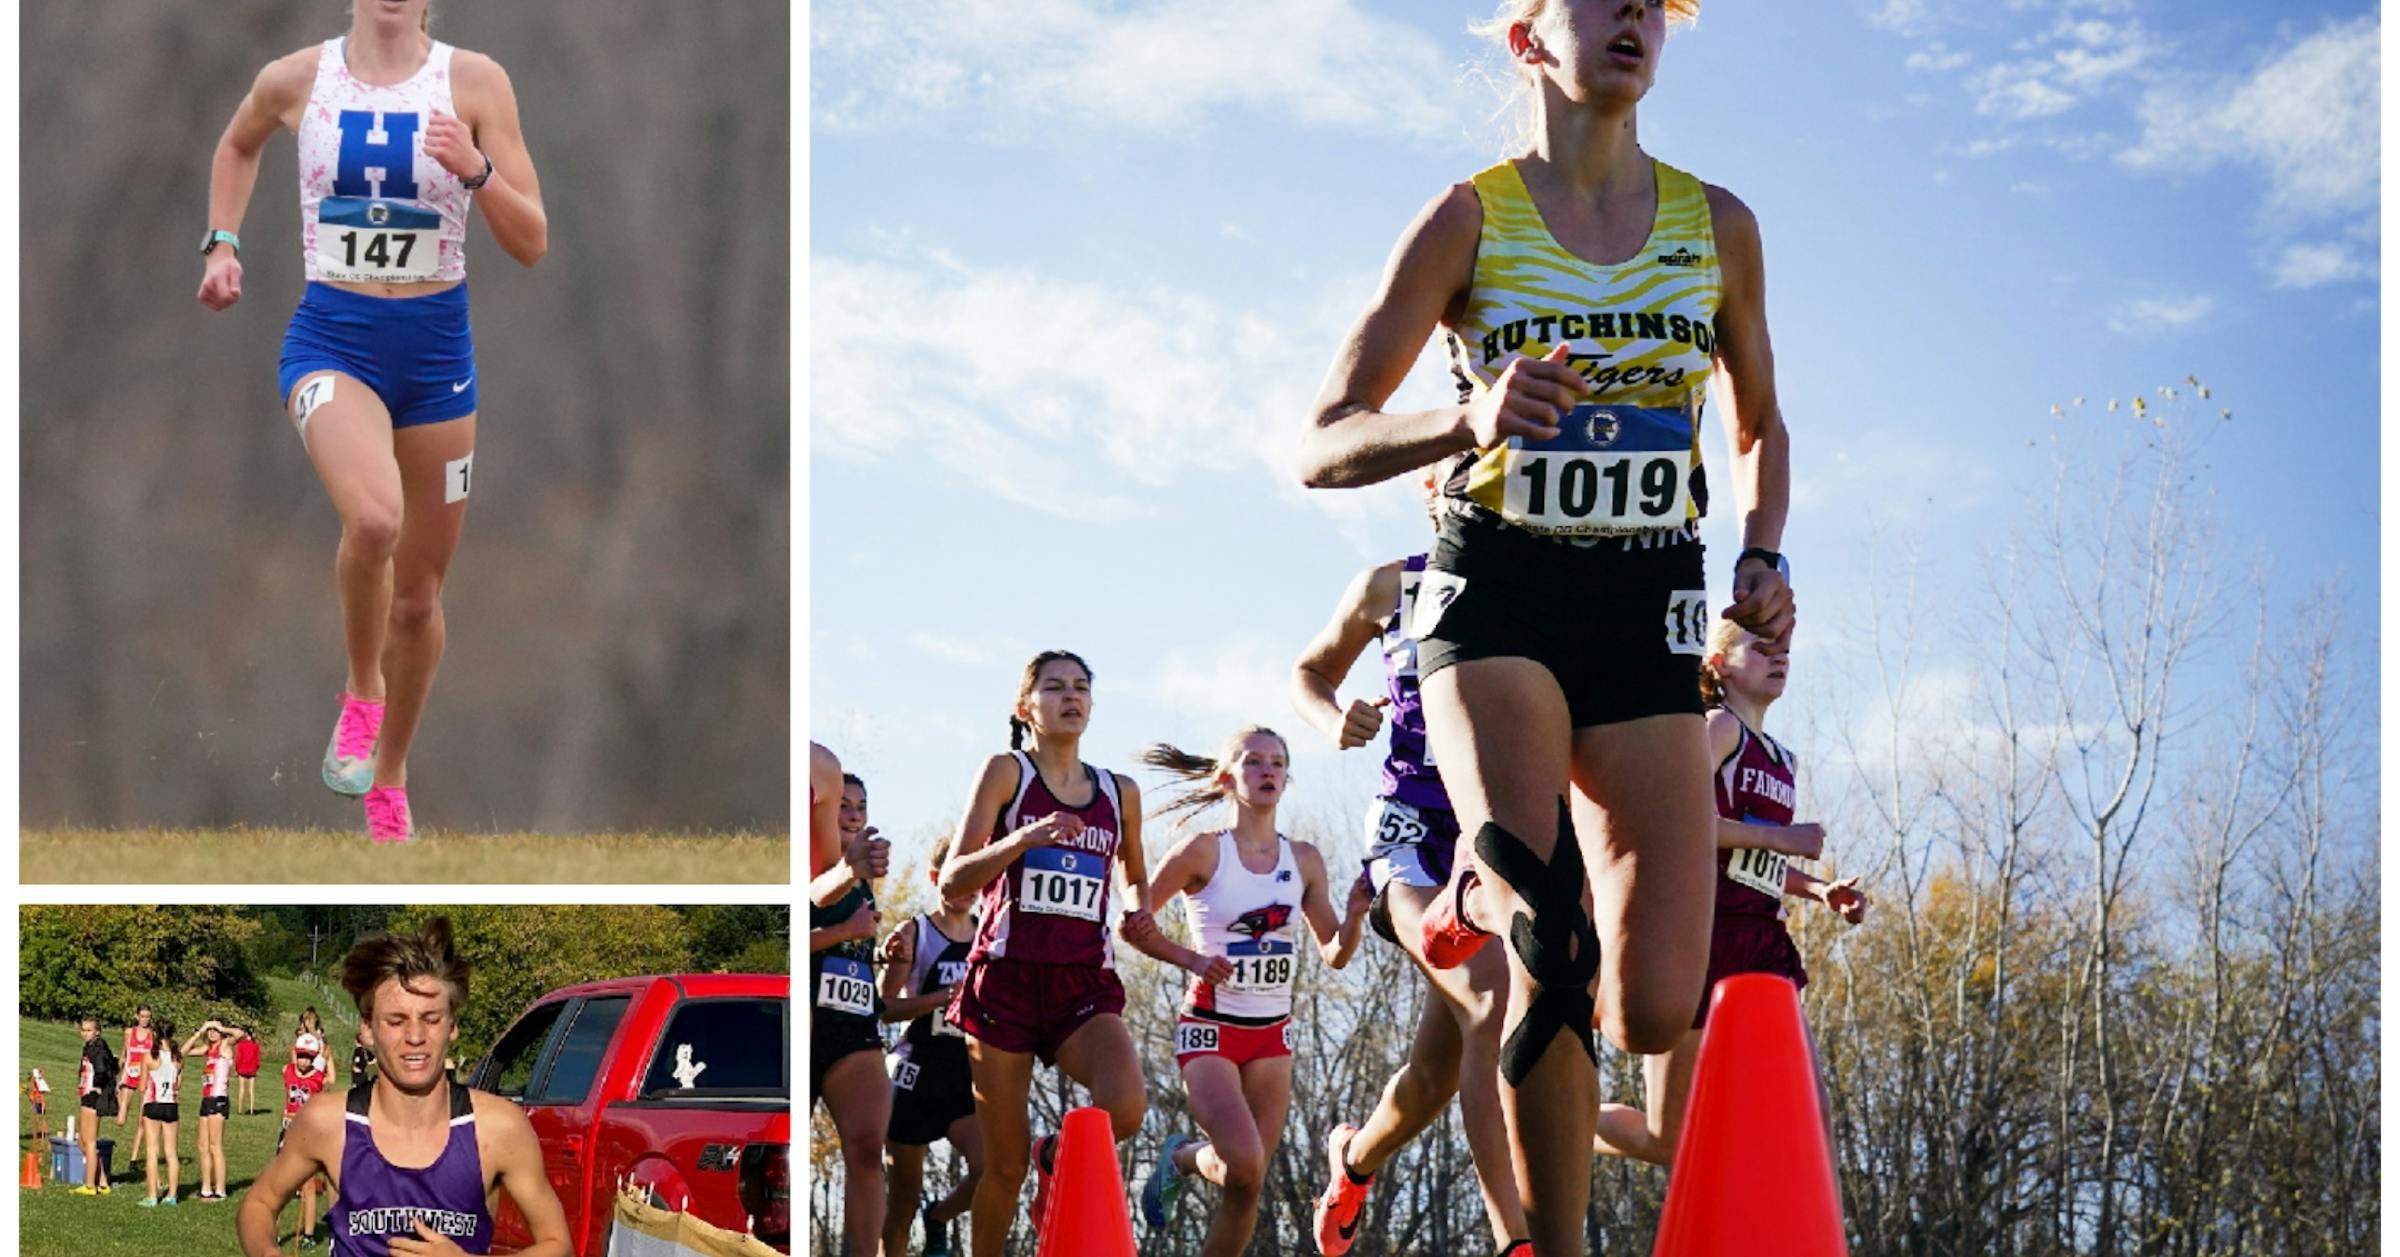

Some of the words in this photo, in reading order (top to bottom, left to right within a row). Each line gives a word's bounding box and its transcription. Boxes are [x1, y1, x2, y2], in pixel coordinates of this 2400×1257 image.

[332, 109, 419, 199] H
[340, 231, 417, 268] 147
[458, 462, 469, 493] 1
[1519, 457, 1678, 518] 1019
[1739, 849, 1787, 887] 1016
[1029, 872, 1100, 909] 1017
[1233, 957, 1291, 984] 1189
[825, 977, 871, 1008] 1029
[1179, 1027, 1218, 1049] 189
[894, 1060, 917, 1087] 15
[348, 1206, 478, 1237] SOUTHWEST
